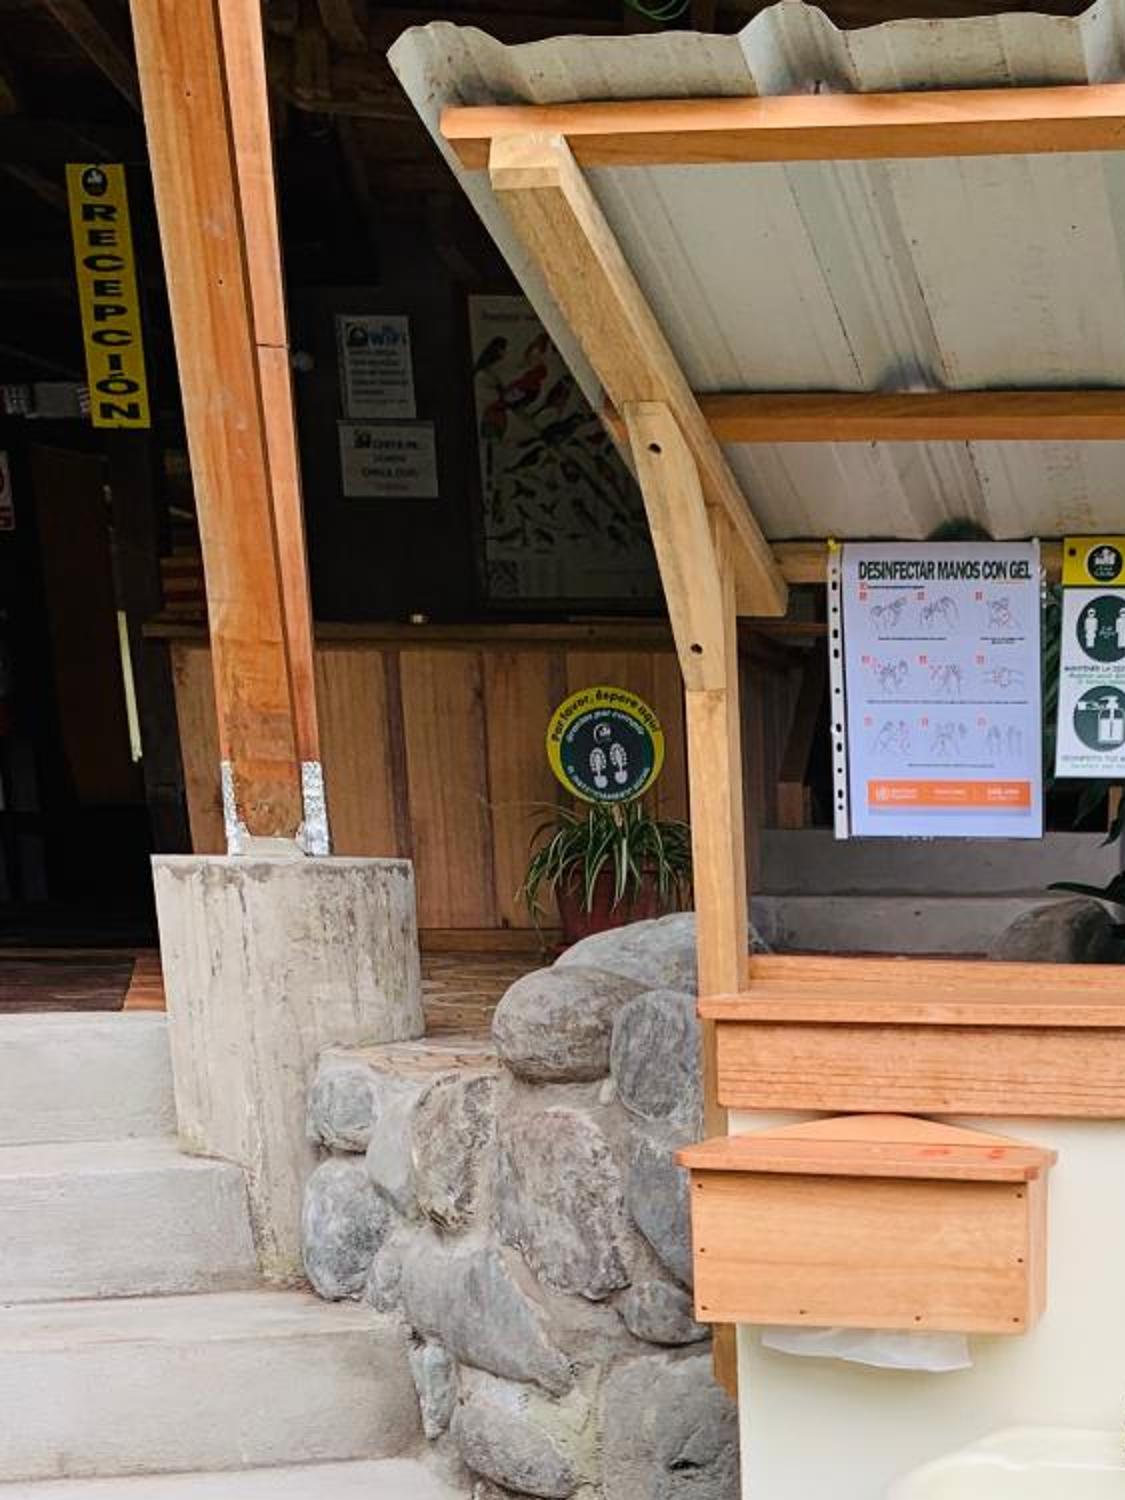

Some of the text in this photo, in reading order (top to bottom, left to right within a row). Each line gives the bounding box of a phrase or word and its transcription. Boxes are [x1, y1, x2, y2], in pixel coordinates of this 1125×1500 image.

[82, 203, 141, 420] RECEPCIÓN
[858, 560, 1033, 580] DESINFECTAR MANOS CON GEL
